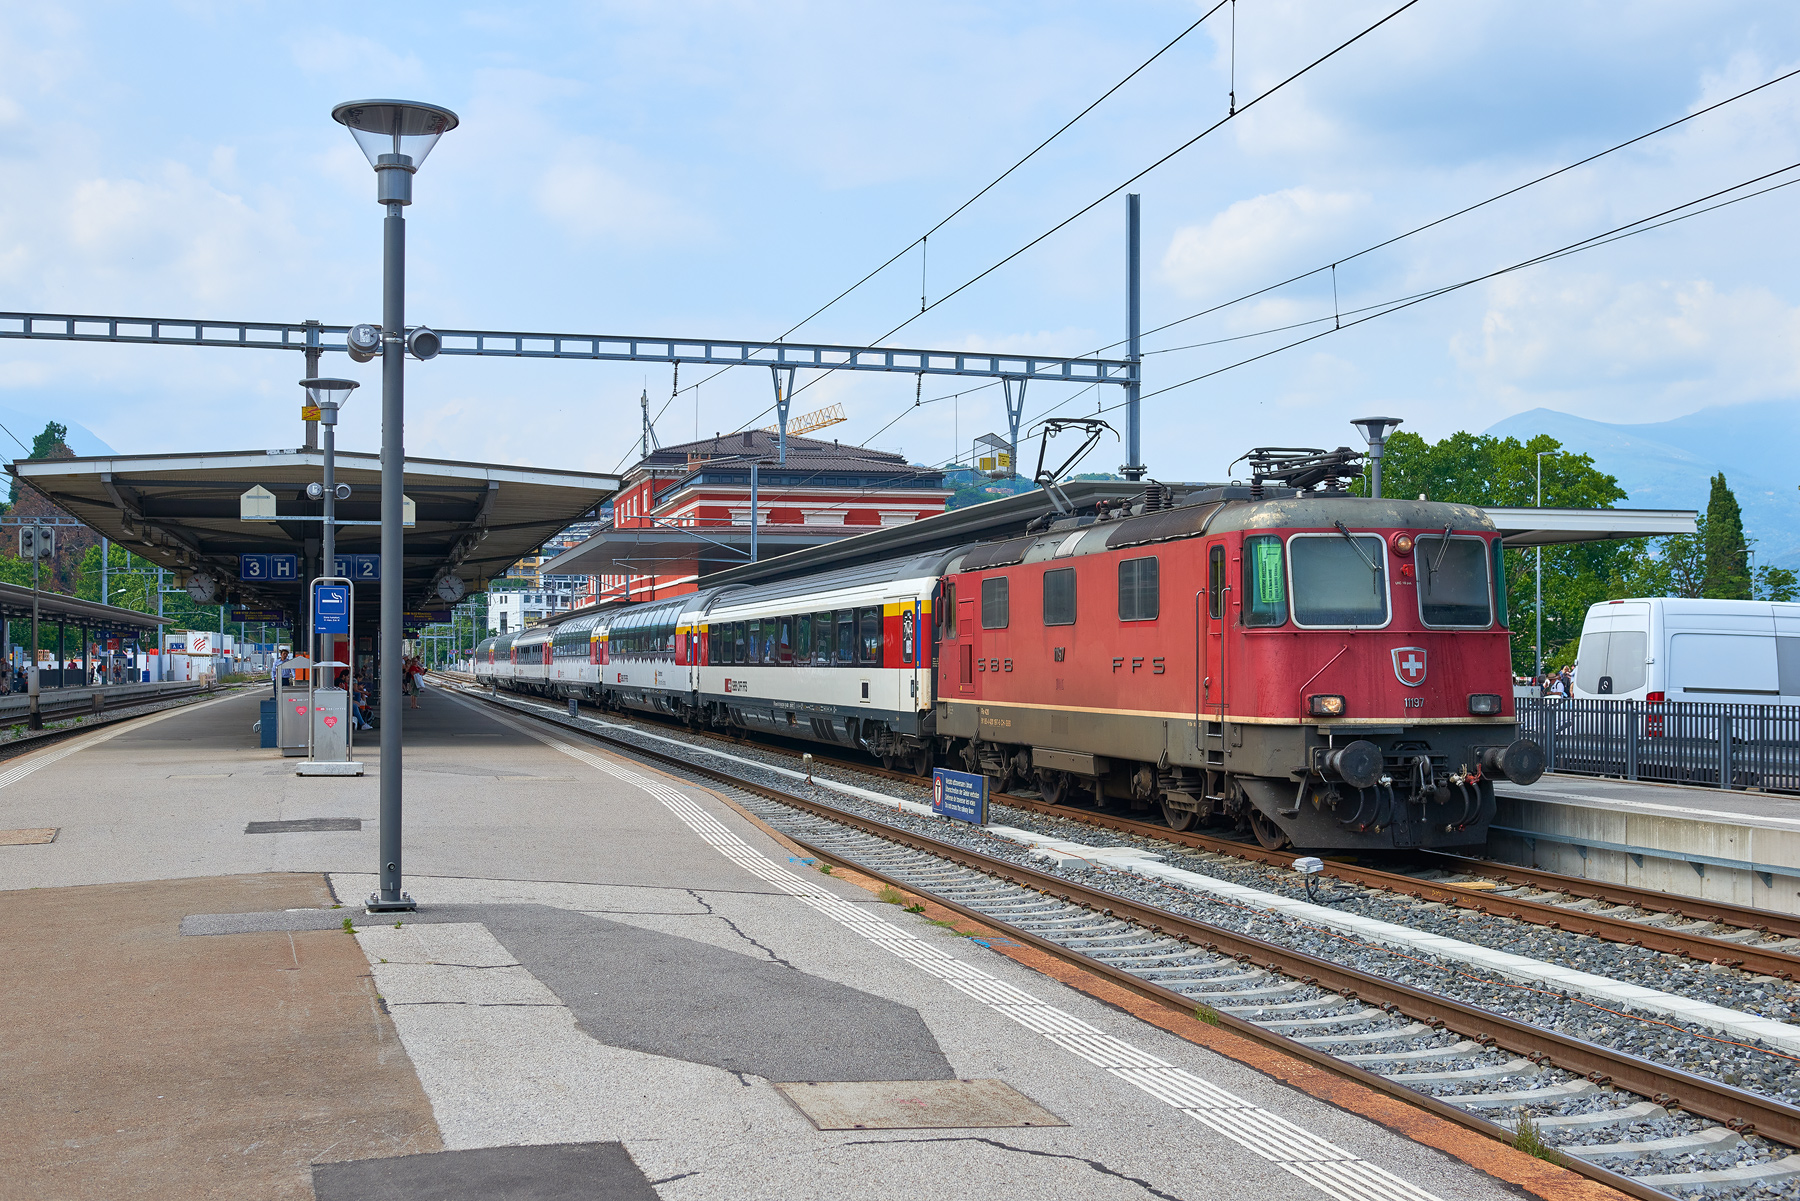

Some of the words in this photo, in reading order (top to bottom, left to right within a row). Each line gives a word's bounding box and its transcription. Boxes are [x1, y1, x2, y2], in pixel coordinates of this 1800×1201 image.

[250, 562, 260, 576] 3
[278, 562, 290, 576] H
[334, 562, 346, 576] H
[362, 562, 373, 576] 2
[918, 604, 920, 620] 1
[977, 658, 1013, 672] SBB
[1112, 657, 1165, 674] FFS
[1404, 698, 1424, 708] 11197
